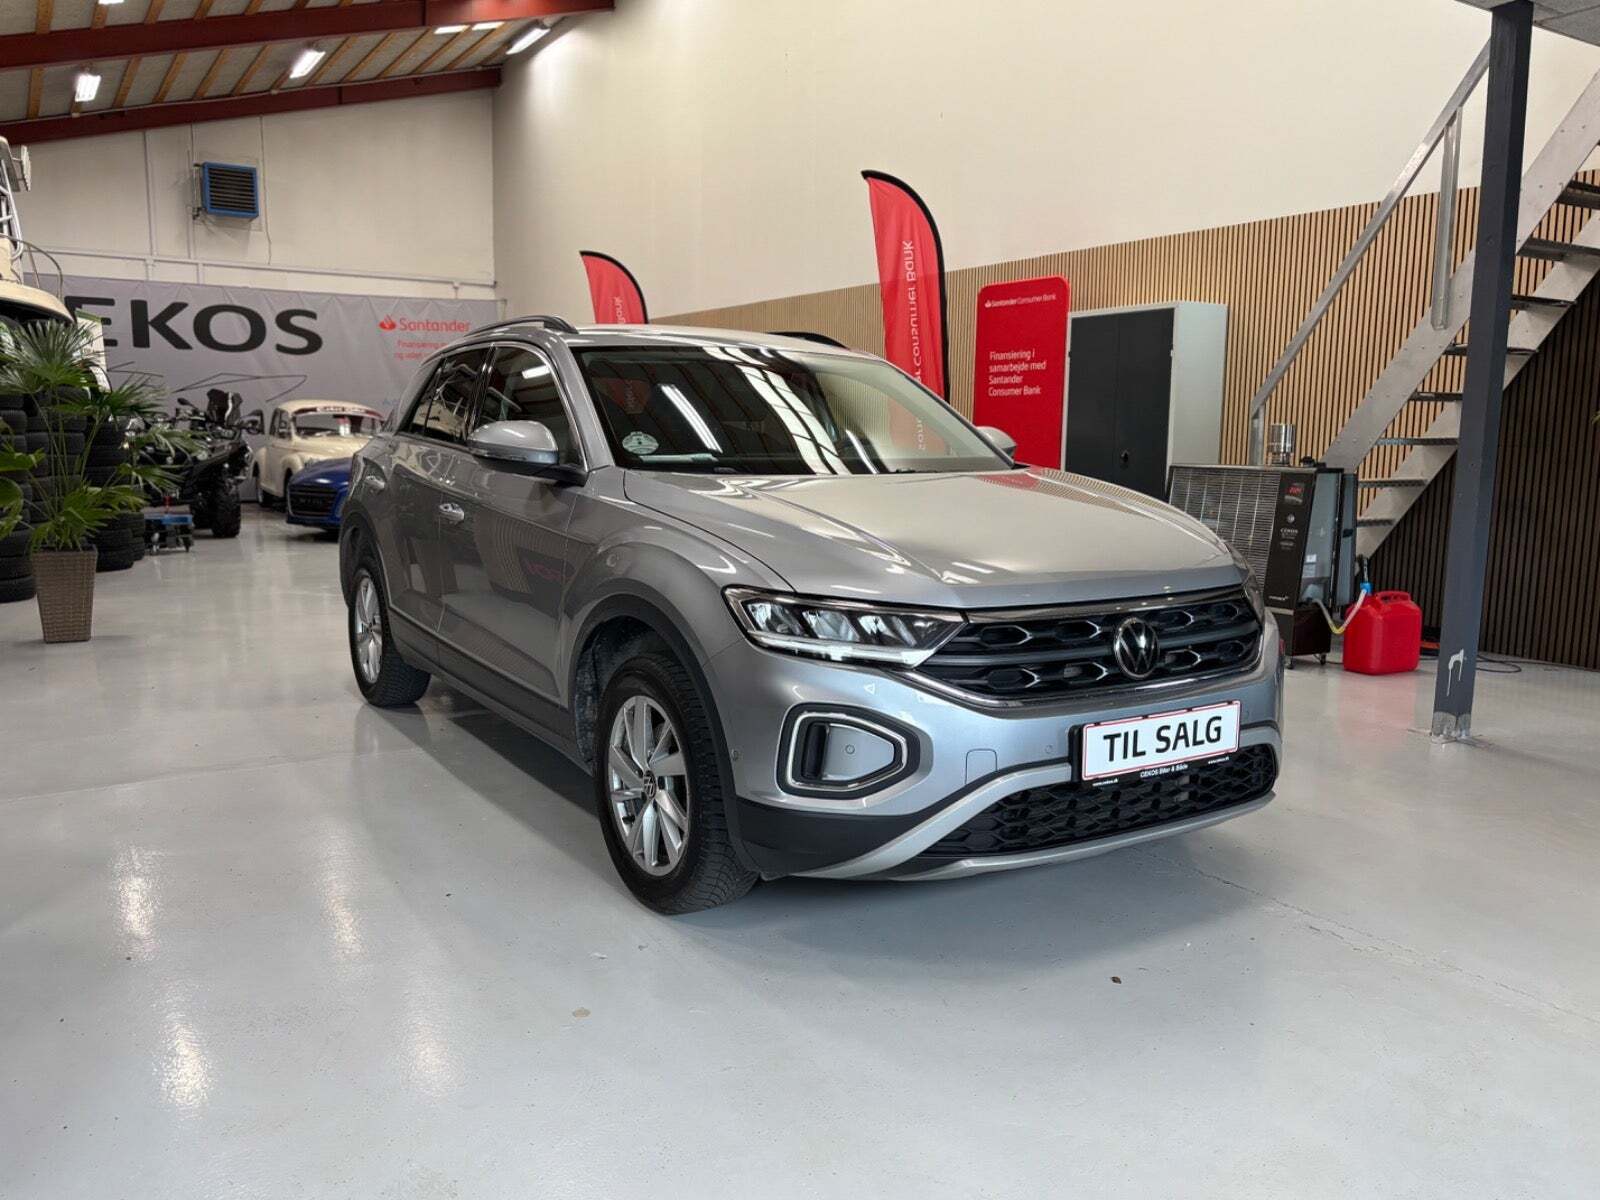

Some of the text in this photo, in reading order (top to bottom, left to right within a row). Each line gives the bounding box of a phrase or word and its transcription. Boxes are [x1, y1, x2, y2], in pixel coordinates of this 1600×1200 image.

[399, 318, 470, 332] Santander
[989, 350, 1031, 361] Finansiering
[989, 360, 1047, 374] samarbejde med
[989, 374, 1023, 385] Santander
[988, 385, 1042, 397] Consumer Bank
[1103, 716, 1222, 762] TIL SALG
